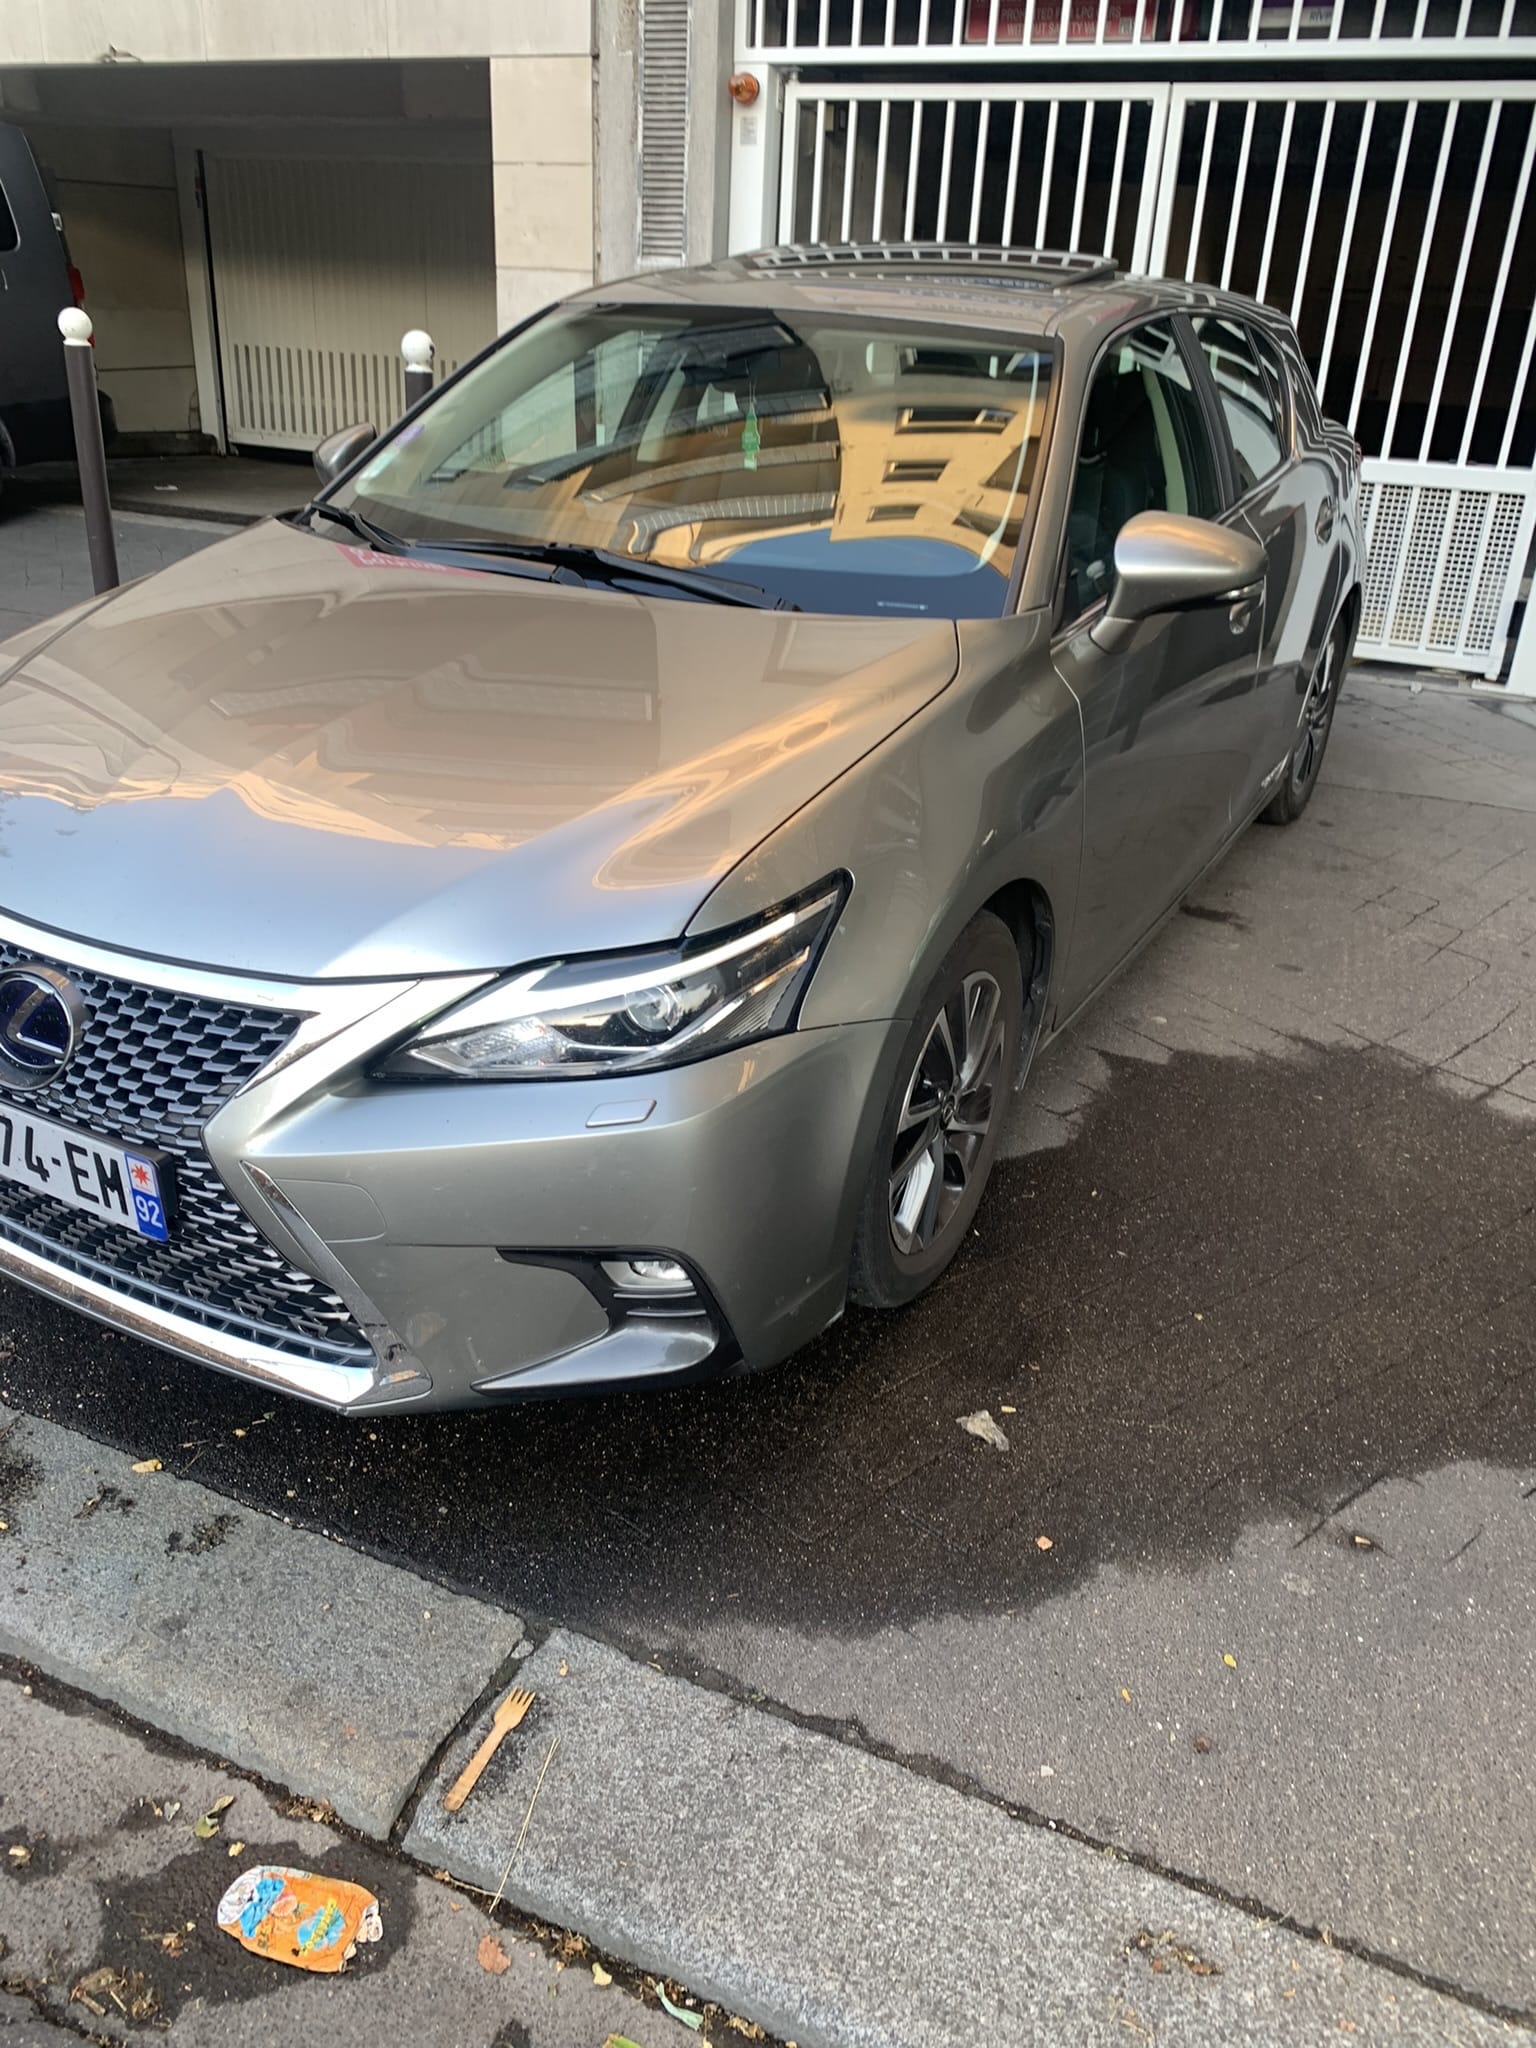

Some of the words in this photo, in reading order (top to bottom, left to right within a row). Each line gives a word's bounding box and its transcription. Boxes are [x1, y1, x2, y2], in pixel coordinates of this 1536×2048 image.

[1001, 7, 1054, 21] PROHTED
[1007, 22, 1046, 36] WITUT
[1048, 21, 1083, 35] SATY
[135, 1195, 163, 1228] 92
